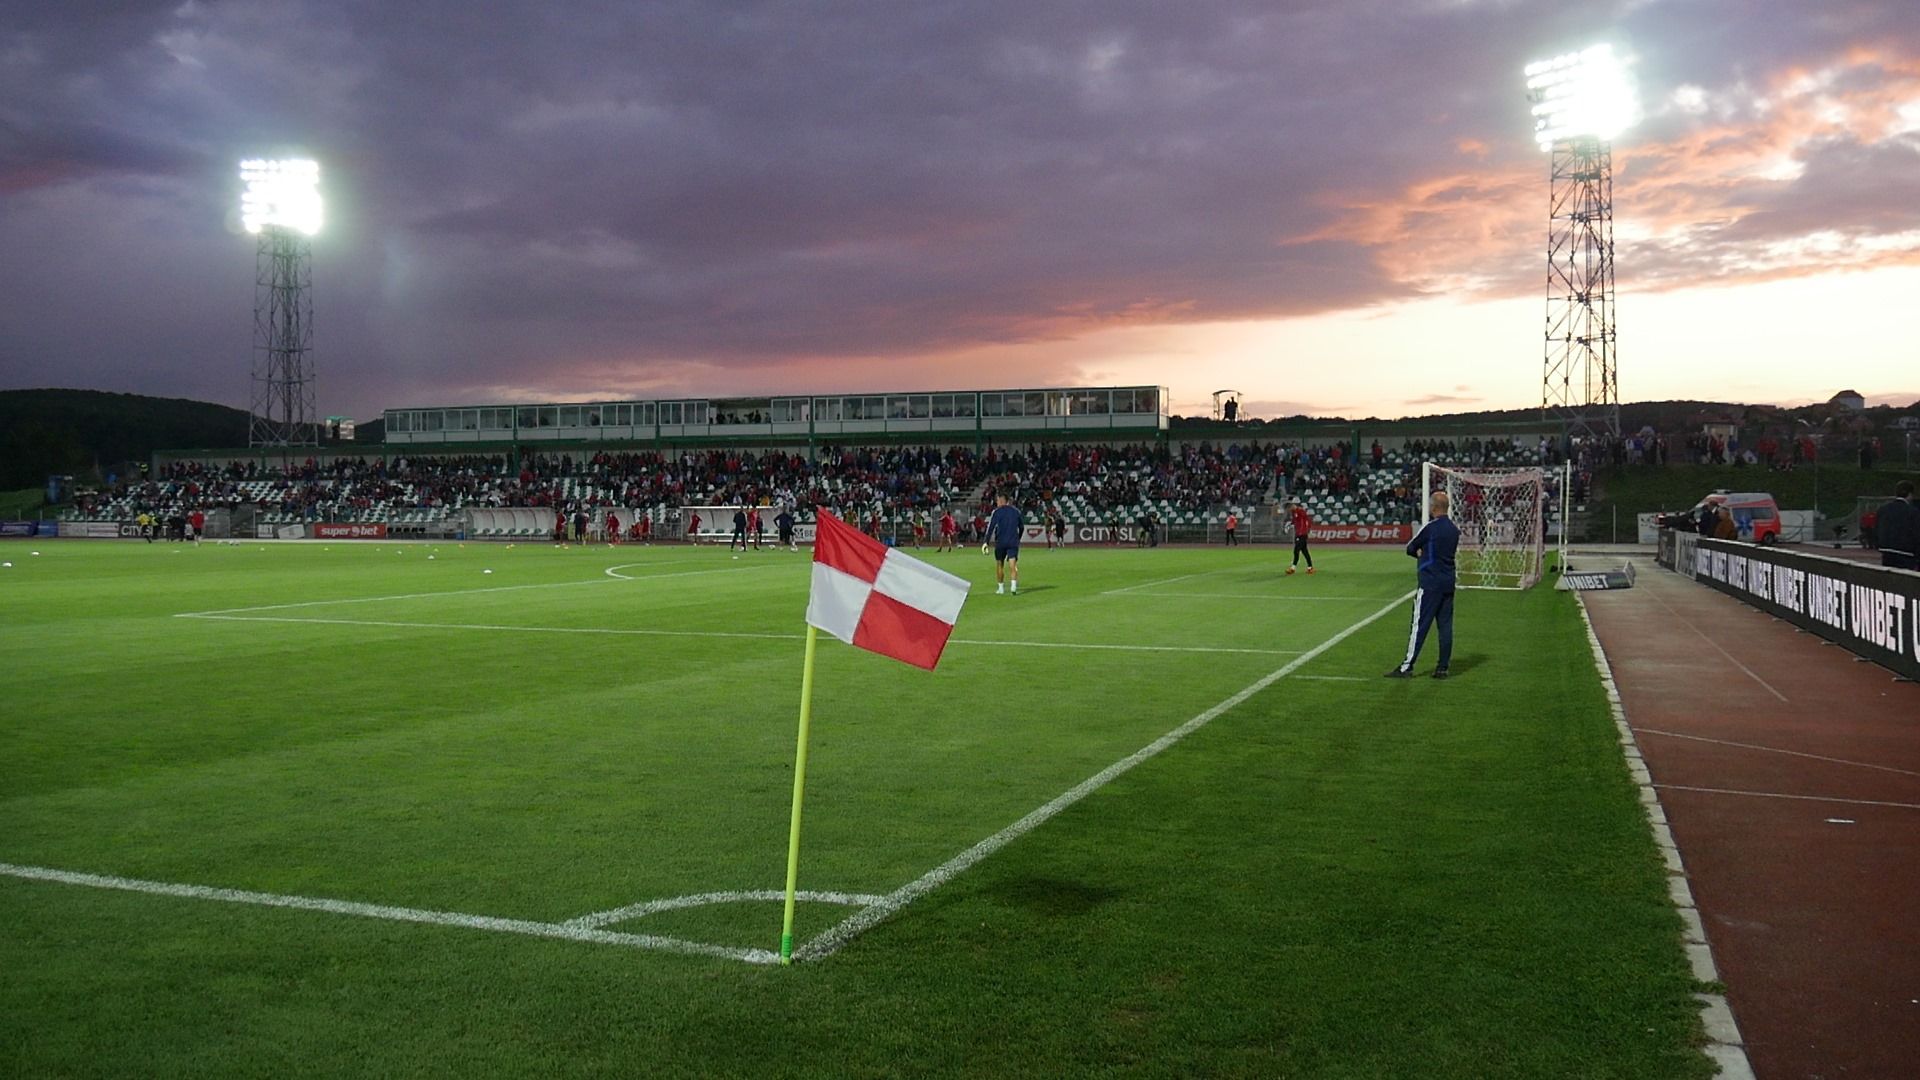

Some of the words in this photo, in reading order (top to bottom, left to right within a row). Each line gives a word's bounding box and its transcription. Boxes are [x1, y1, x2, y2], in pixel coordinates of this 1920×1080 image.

[121, 525, 142, 536] CITY
[320, 526, 350, 536] super
[360, 525, 379, 536] bet
[1080, 526, 1118, 541] CITY
[1119, 526, 1136, 541] SL
[1308, 528, 1354, 540] super
[1371, 527, 1400, 539] bet
[1564, 574, 1609, 590] UNIBET
[1774, 564, 1805, 614] UNIBET
[1808, 572, 1847, 631] UNIBET
[1851, 583, 1906, 654] UNIBET
